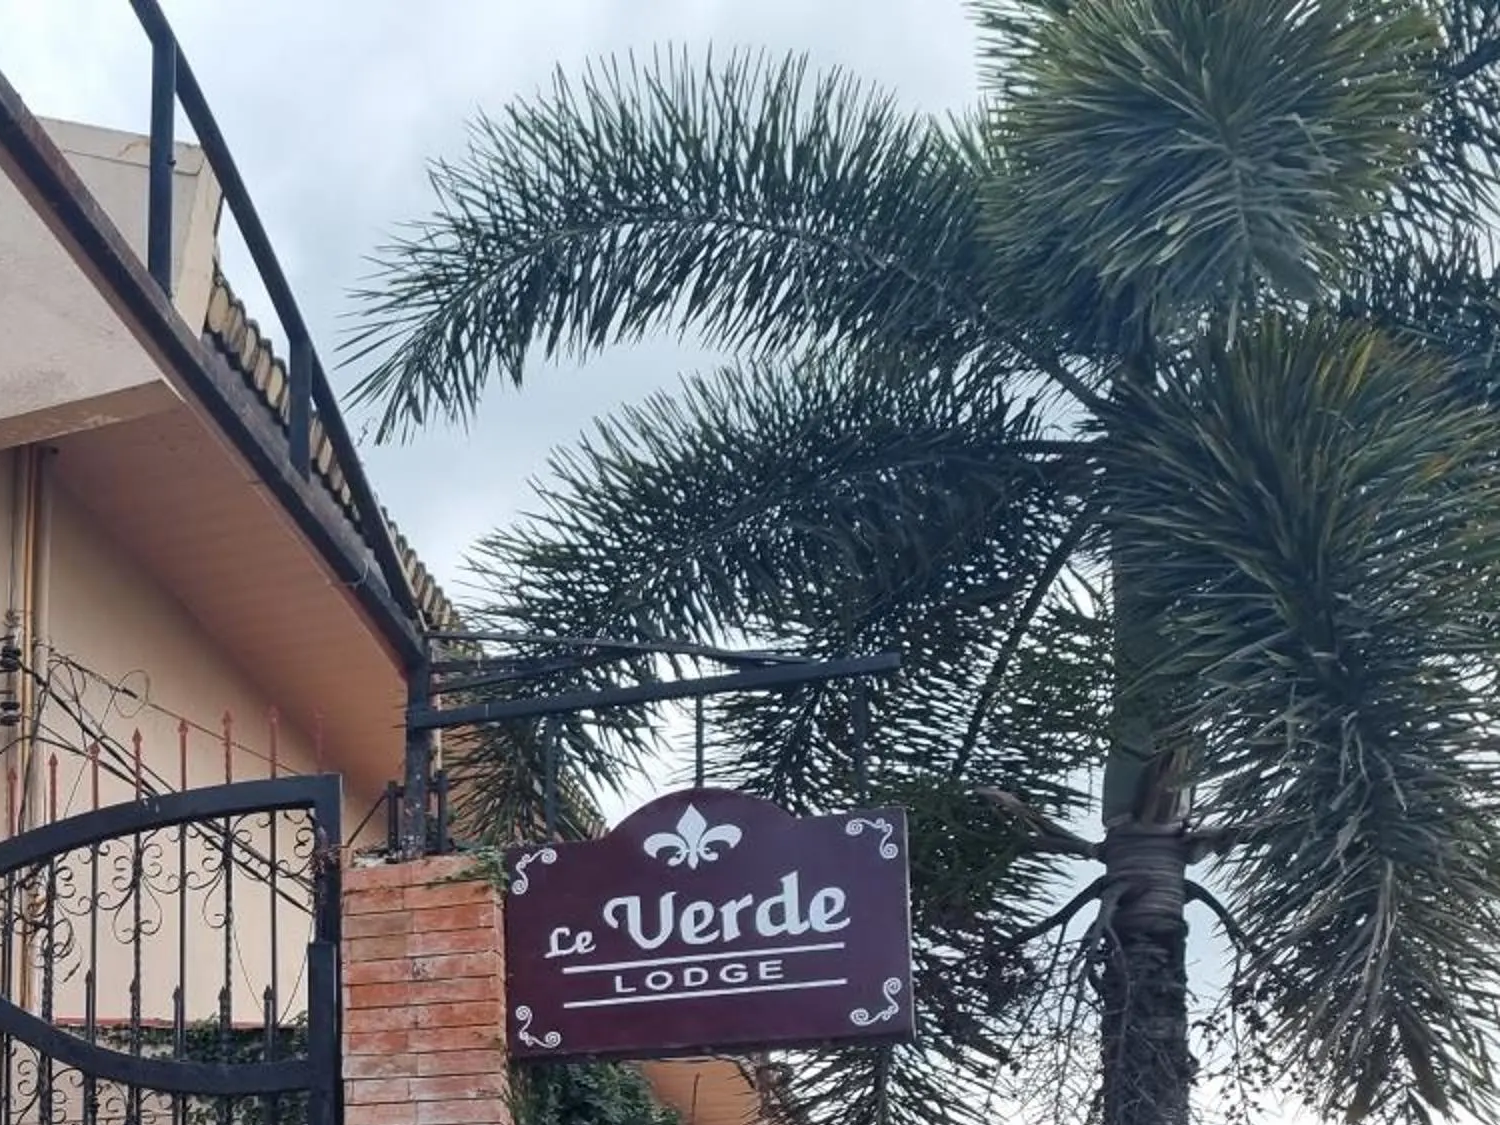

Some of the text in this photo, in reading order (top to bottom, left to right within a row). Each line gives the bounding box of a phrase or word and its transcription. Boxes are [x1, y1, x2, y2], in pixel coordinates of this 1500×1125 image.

[544, 870, 851, 959] Le Verde
[615, 959, 785, 993] LODGE
